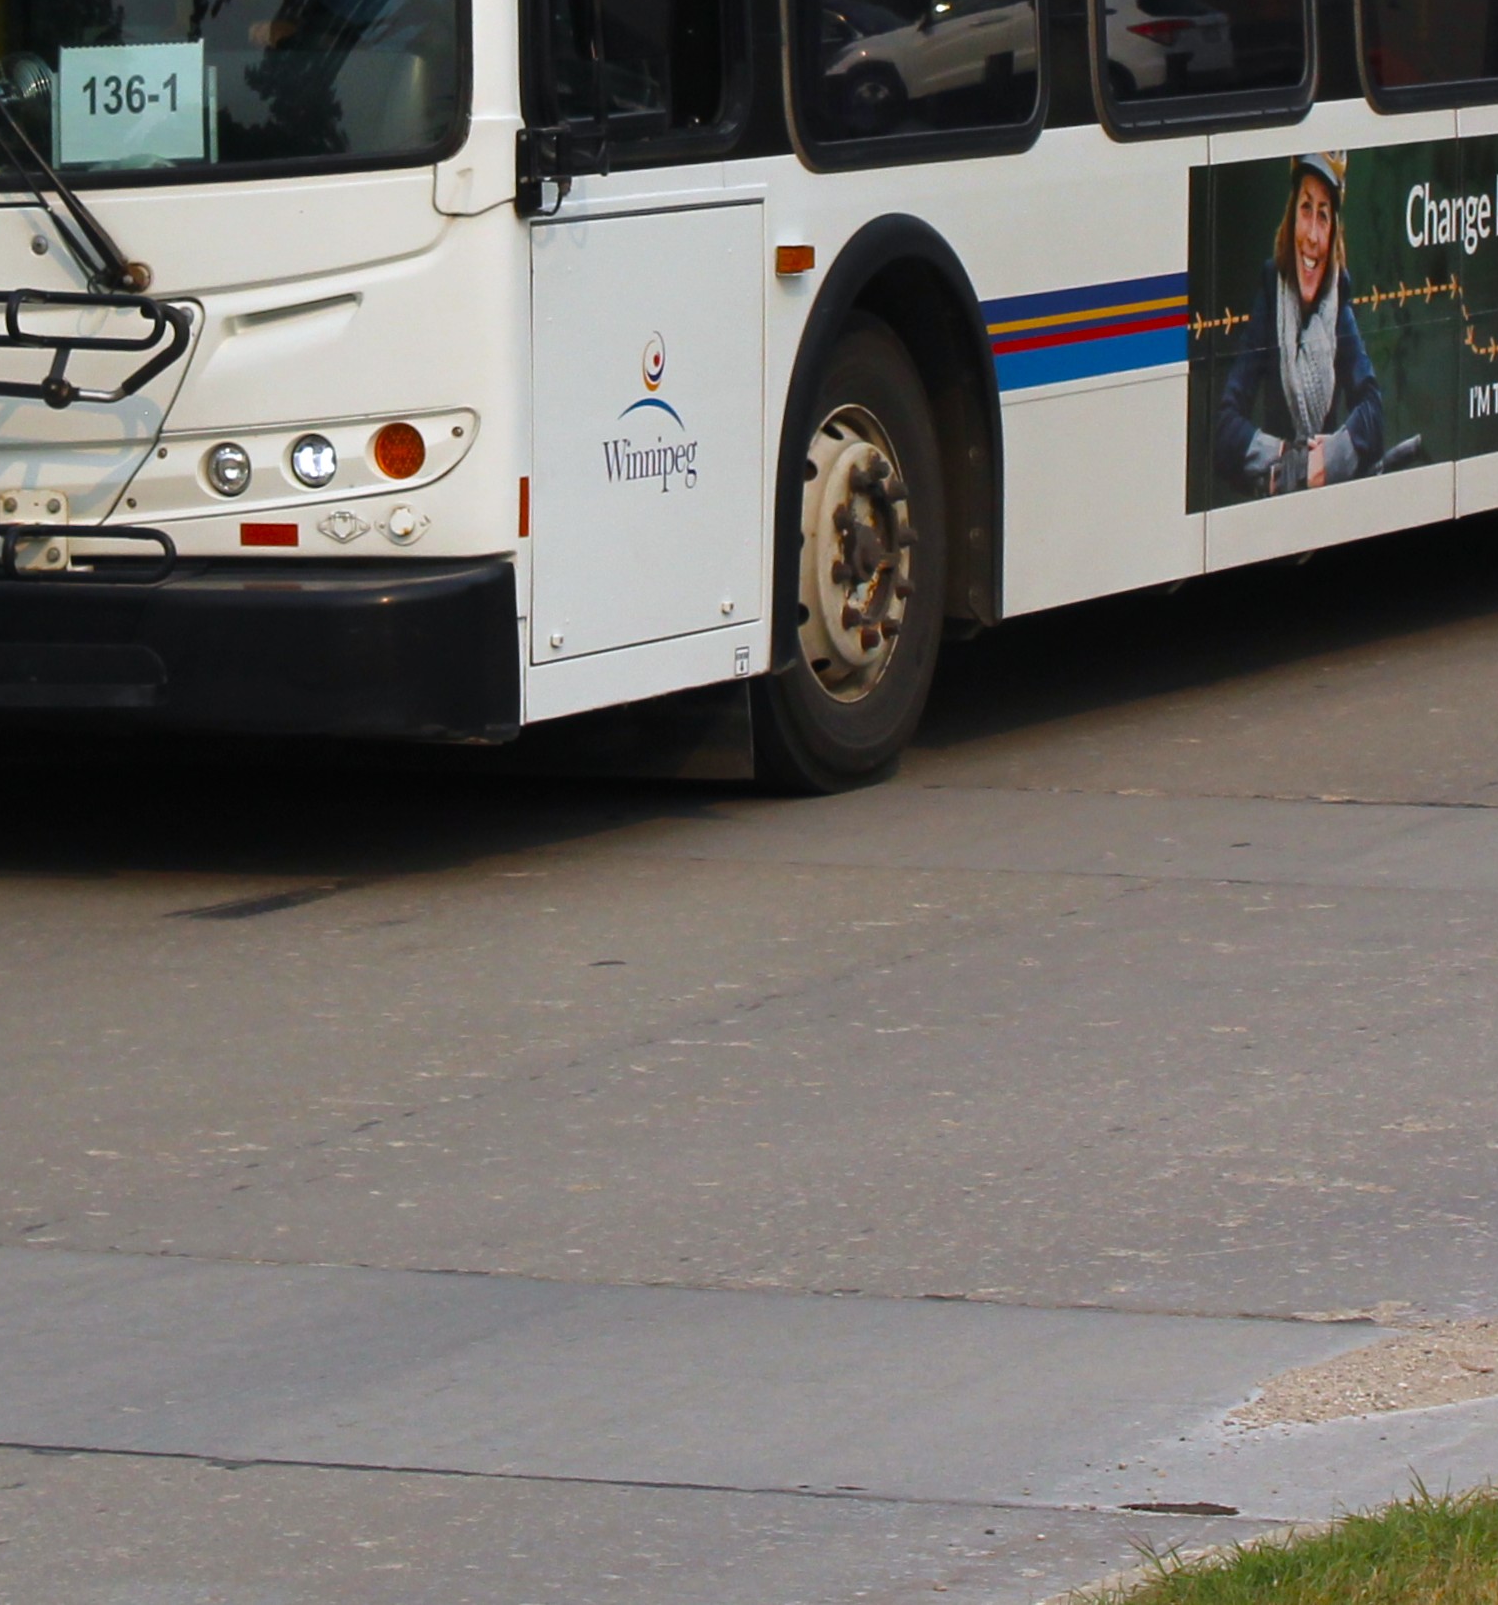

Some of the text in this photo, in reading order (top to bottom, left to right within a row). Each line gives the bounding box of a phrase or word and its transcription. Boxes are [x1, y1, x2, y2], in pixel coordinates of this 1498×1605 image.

[82, 73, 177, 115] 136-1
[1406, 182, 1492, 255] Change
[1469, 384, 1491, 419] I'M
[603, 436, 698, 493] Winnipeg
